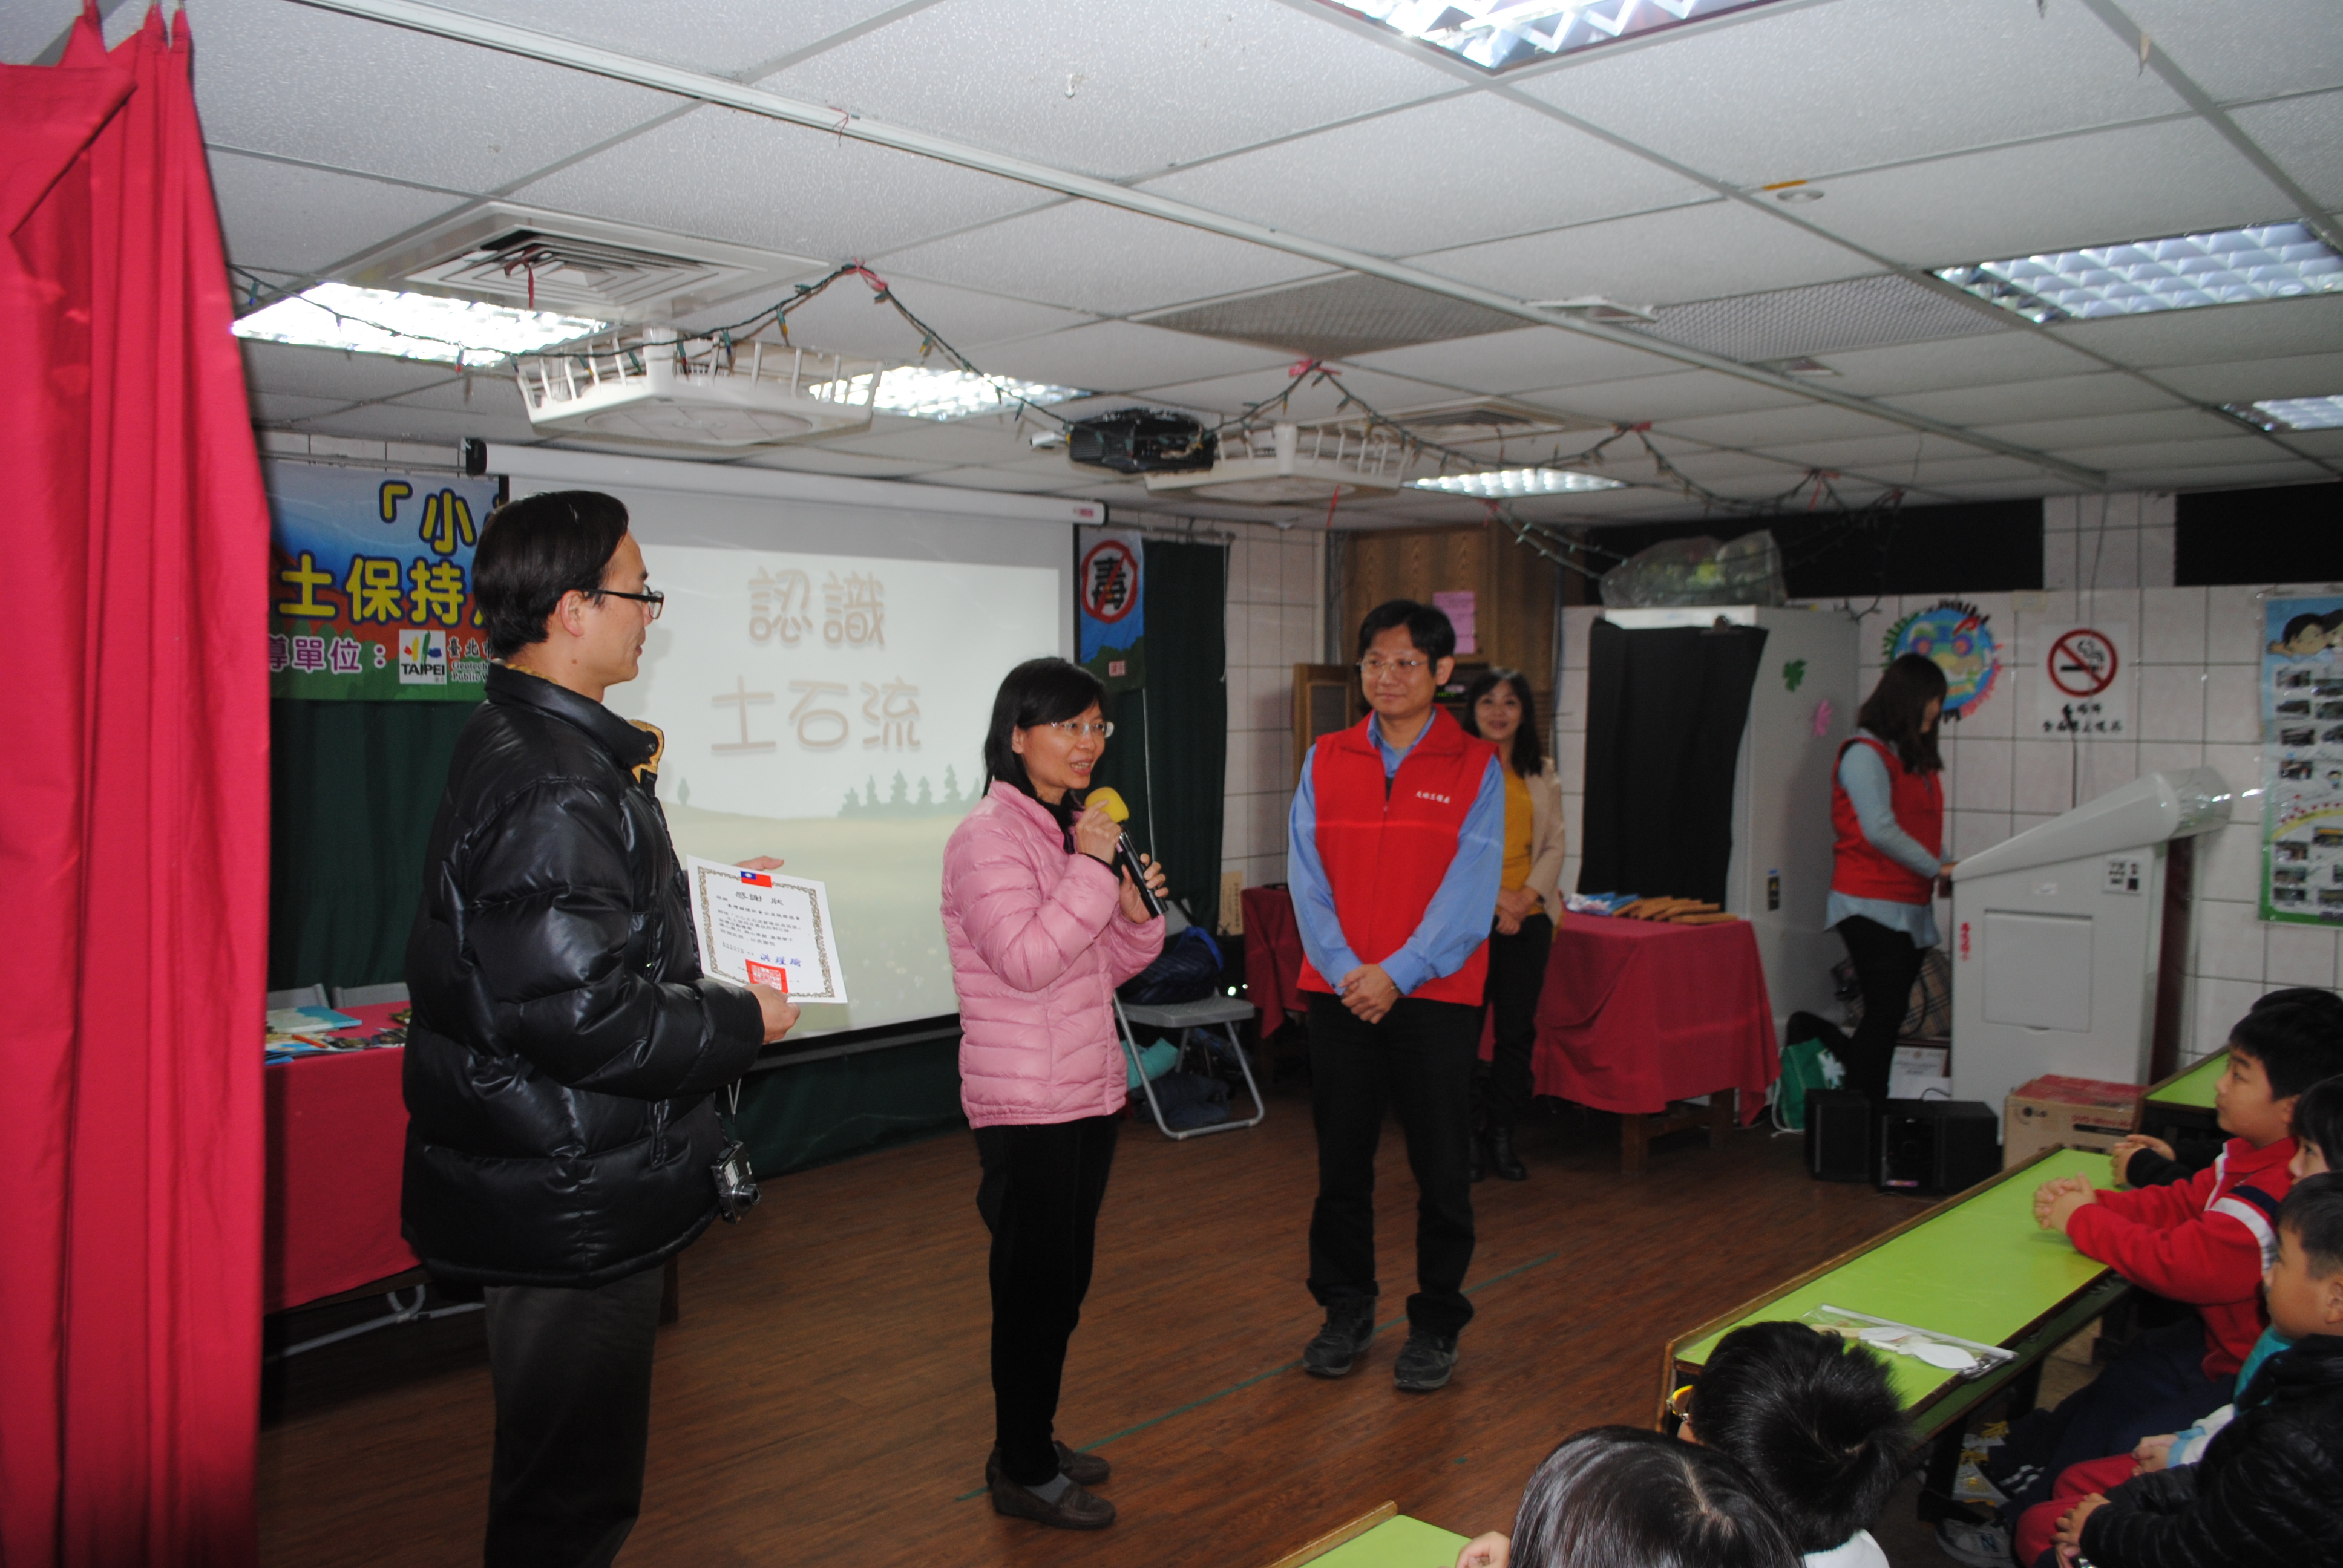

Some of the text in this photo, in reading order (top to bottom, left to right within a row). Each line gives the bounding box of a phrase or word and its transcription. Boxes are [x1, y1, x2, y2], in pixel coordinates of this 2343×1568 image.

[277, 552, 484, 626] 土保持
[747, 565, 885, 646] 認識
[401, 663, 445, 676] TAIPEI
[453, 672, 480, 681] Public
[711, 673, 922, 751] 土石流
[735, 890, 784, 906] 感謝狀
